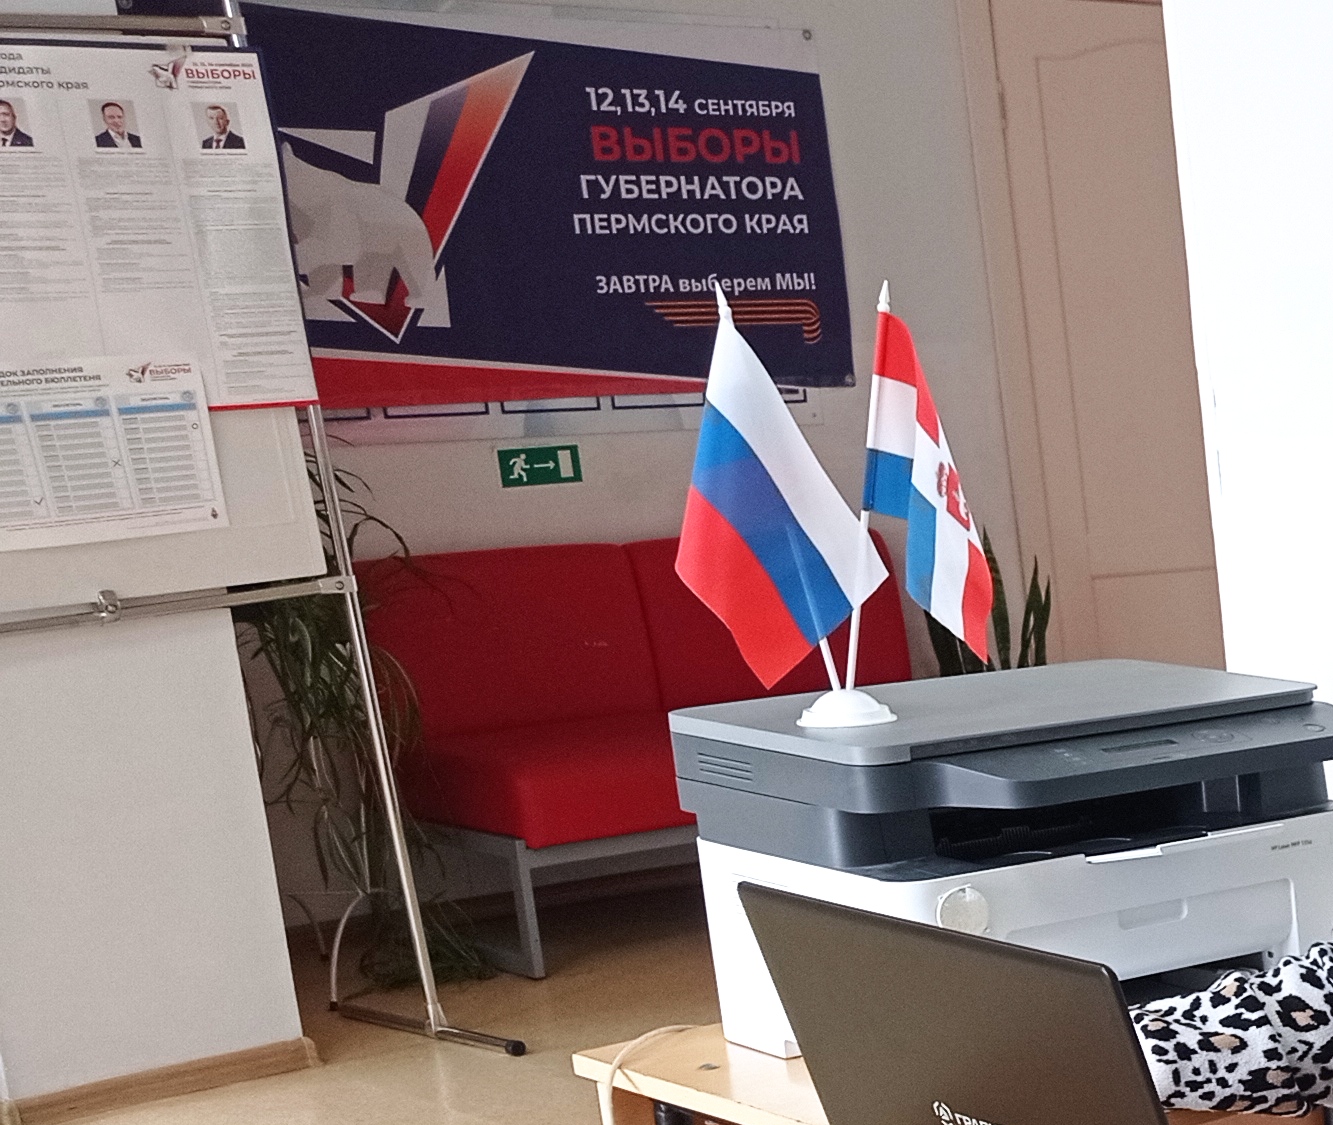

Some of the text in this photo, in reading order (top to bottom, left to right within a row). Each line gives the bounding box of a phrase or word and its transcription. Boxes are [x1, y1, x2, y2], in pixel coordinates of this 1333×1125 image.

[185, 68, 256, 80] ВЫБОРЫ
[585, 86, 796, 118] 12,13,14 СЕНТЯБРЯ
[590, 125, 801, 164] ВЫБОРЫ
[580, 174, 804, 200] ГУБЕРНАТОРА
[573, 213, 809, 235] ПЕРМСКОГО КРАЯ
[595, 274, 675, 294] ЗАВТРА
[776, 272, 817, 290] МЫ!
[19, 366, 84, 377] ЗАПОЛНЕНИЯ
